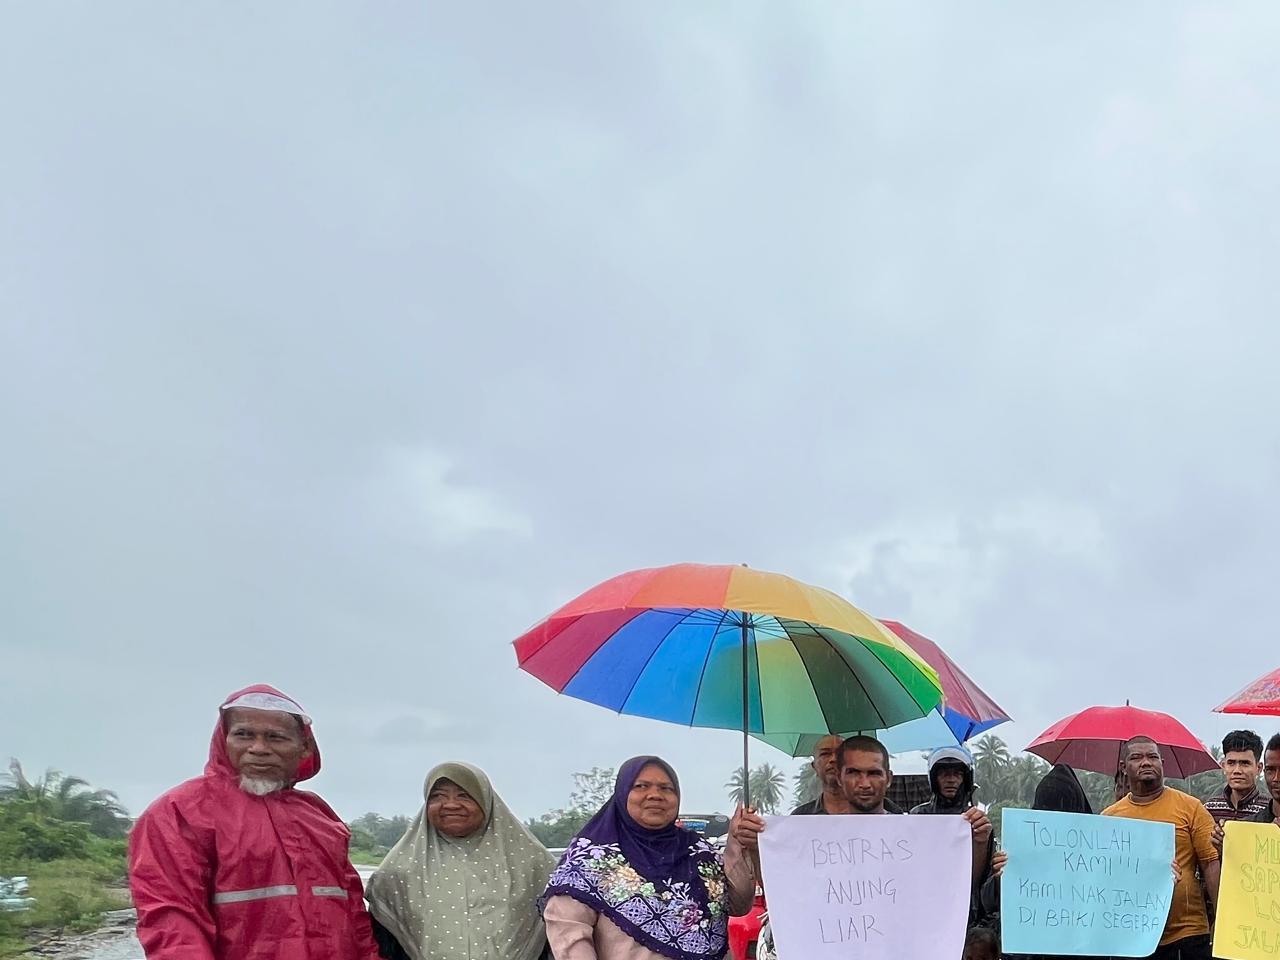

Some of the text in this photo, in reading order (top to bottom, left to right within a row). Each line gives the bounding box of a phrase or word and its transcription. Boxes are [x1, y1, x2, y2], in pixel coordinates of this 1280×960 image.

[1024, 820, 1132, 852] TOLONLAH
[1063, 851, 1112, 876] KAMI
[826, 878, 897, 905] ANJING
[1018, 877, 1168, 911] KAMI NAK JALAN
[818, 914, 885, 944] LIAR
[1018, 906, 1037, 926] DI
[1045, 909, 1095, 927] BAIKI
